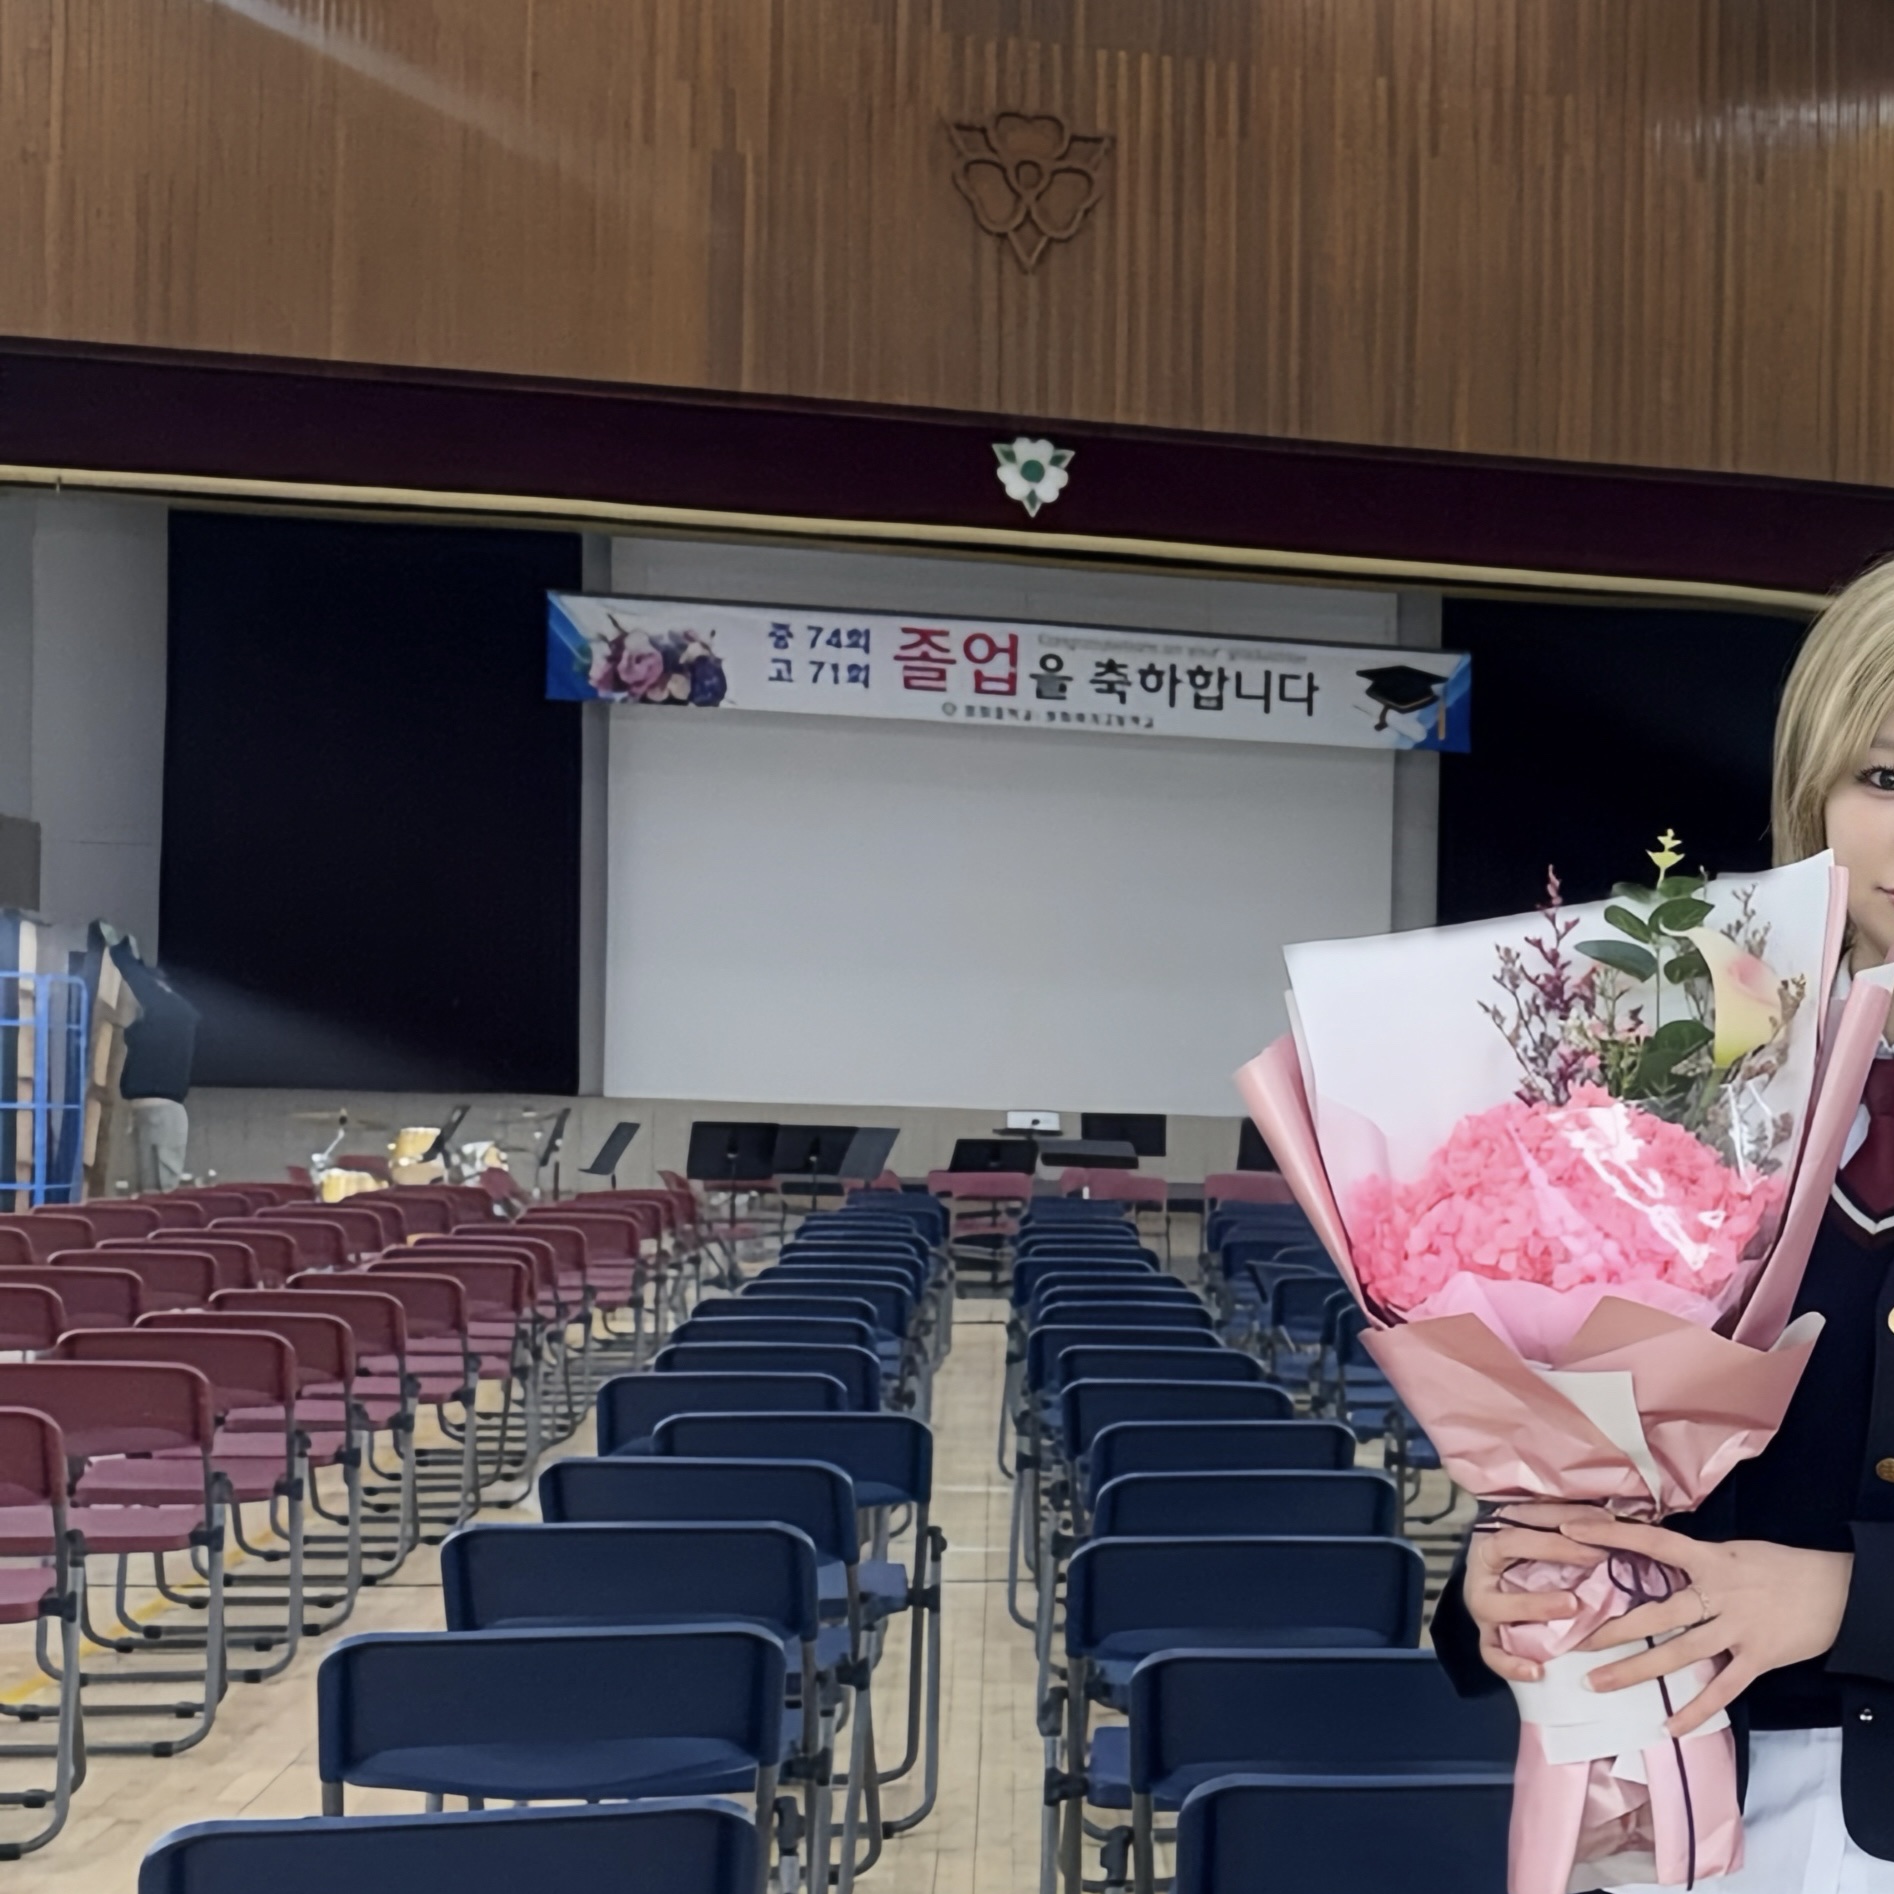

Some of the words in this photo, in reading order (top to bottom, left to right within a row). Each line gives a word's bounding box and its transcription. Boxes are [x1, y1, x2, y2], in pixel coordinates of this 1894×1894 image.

[767, 657, 794, 683] 고
[893, 626, 1074, 700] 졸업을
[1088, 657, 1320, 717] 축하합니다
